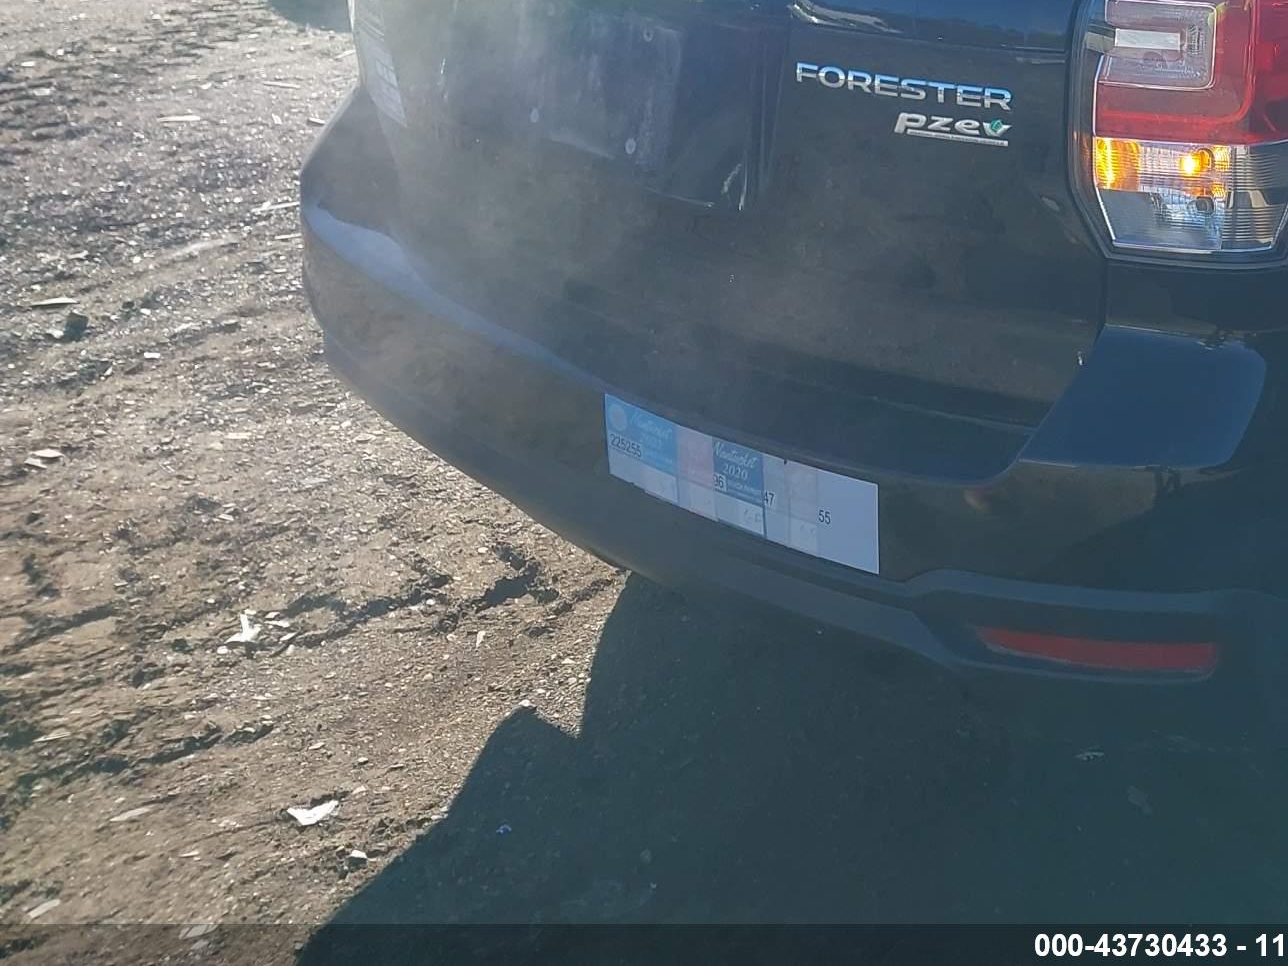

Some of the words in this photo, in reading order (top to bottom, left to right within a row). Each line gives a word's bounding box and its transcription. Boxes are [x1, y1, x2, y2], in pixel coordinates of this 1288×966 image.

[795, 62, 1013, 111] FORESTER
[609, 433, 642, 459] 225255
[722, 463, 749, 481] 2020
[817, 509, 832, 526] 55
